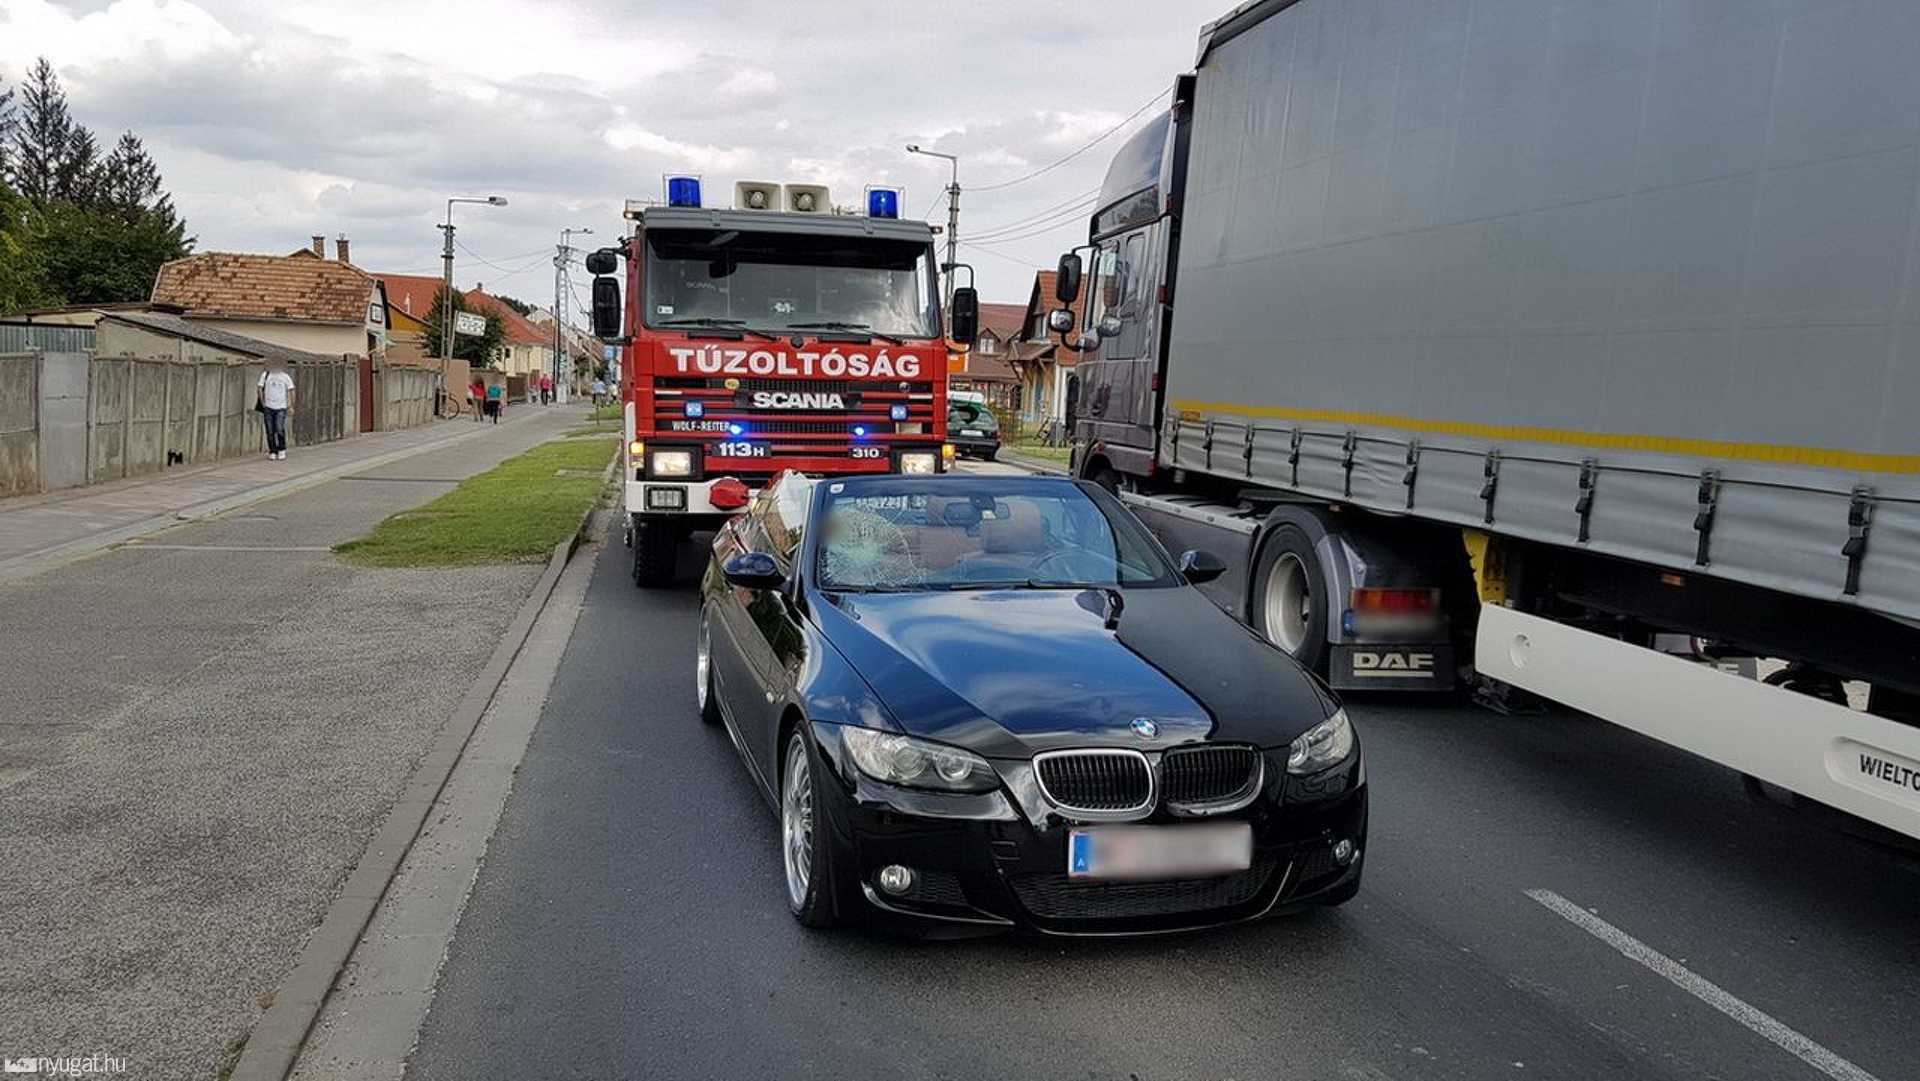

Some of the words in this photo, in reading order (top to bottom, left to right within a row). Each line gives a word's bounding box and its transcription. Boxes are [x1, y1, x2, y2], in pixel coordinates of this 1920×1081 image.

[670, 345, 920, 378] TŰZOLTÓSÁG
[753, 392, 844, 409] SCANIA
[852, 448, 880, 458] 310
[1353, 652, 1433, 669] DAF
